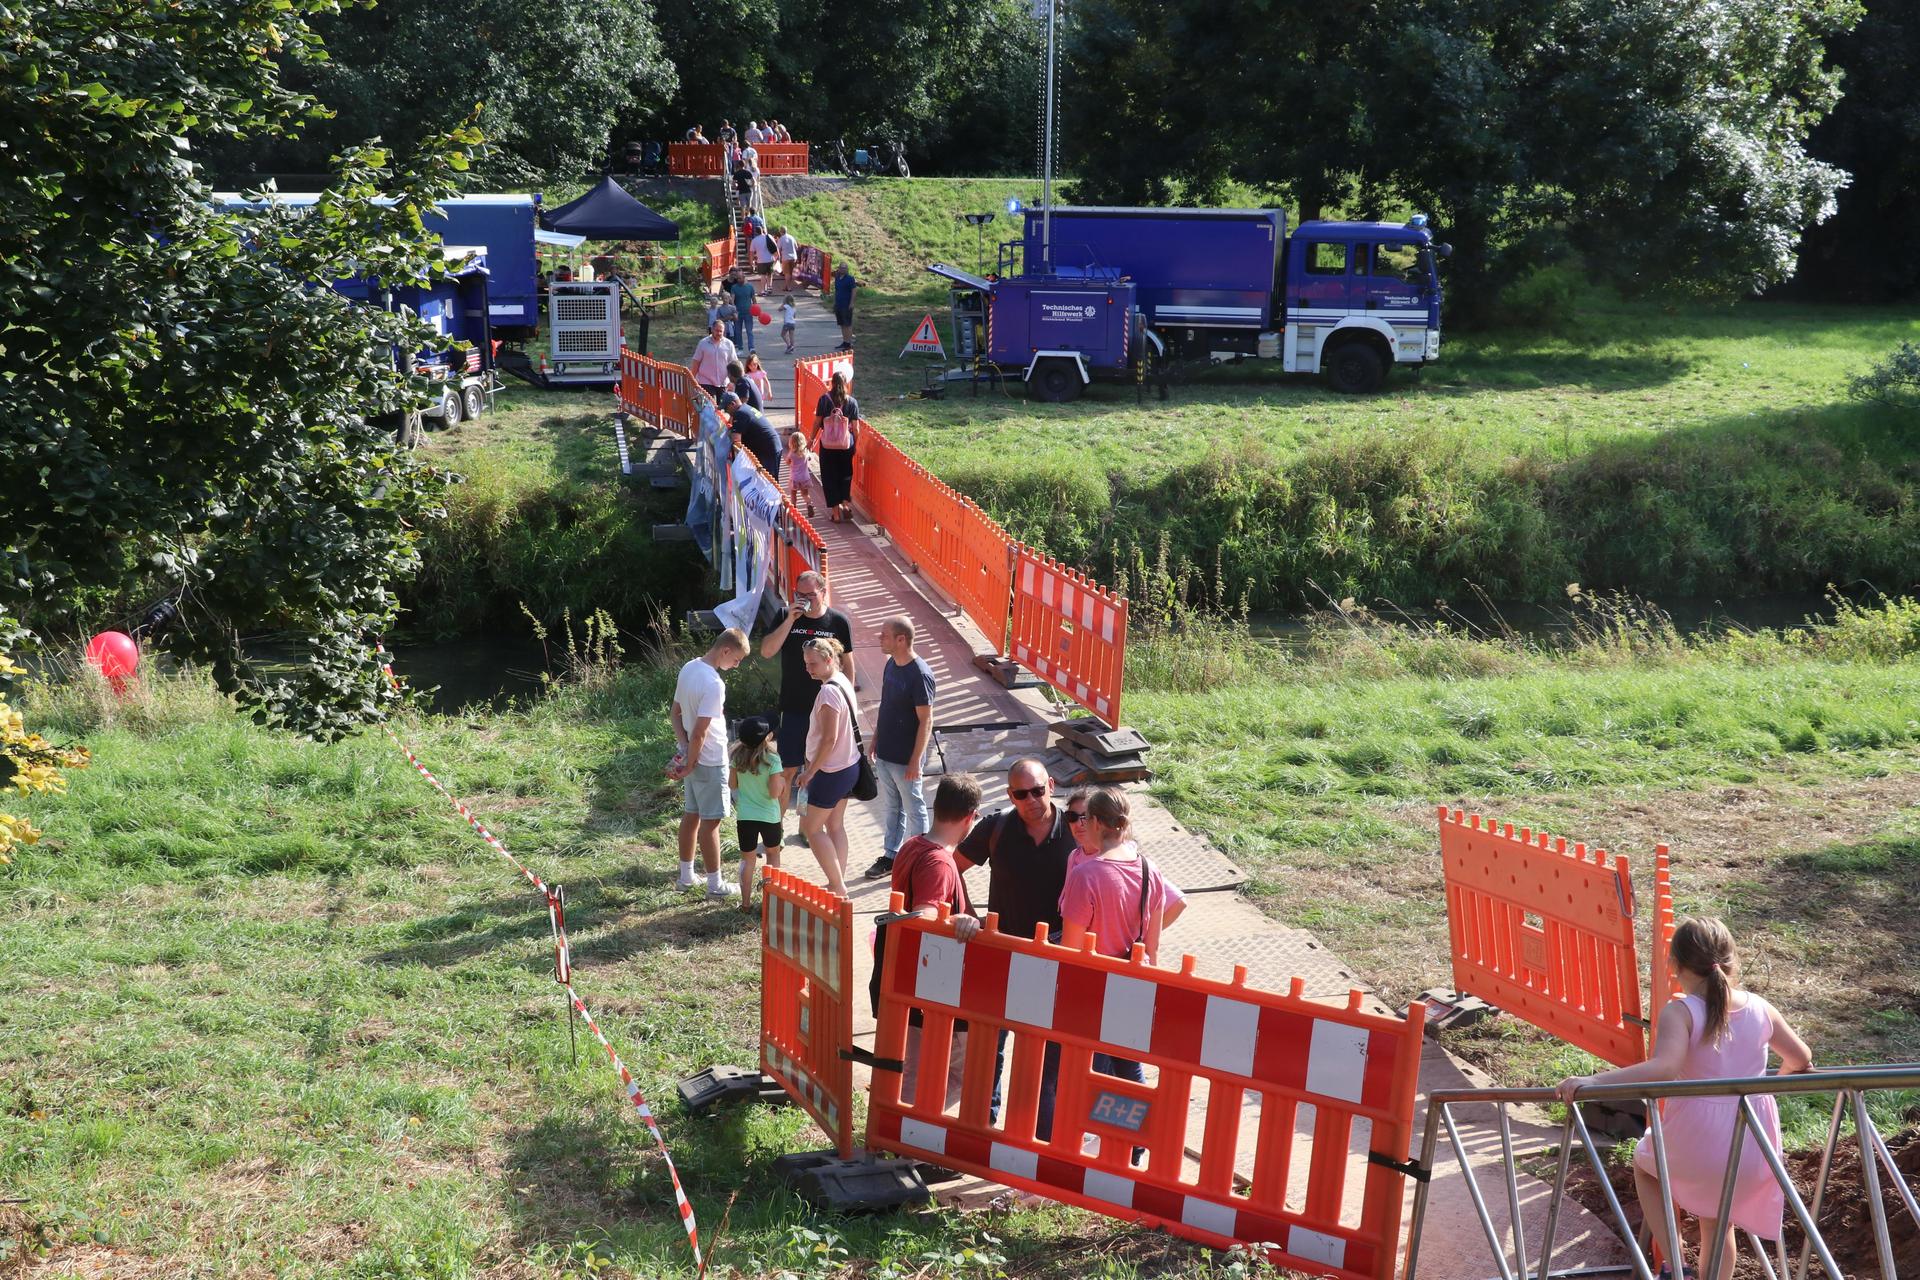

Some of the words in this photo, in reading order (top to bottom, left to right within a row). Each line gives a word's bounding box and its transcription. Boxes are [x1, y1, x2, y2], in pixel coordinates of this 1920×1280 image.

[912, 344, 937, 352] Unfall
[813, 630, 834, 638] JONES
[1094, 1095, 1147, 1124] R+E
